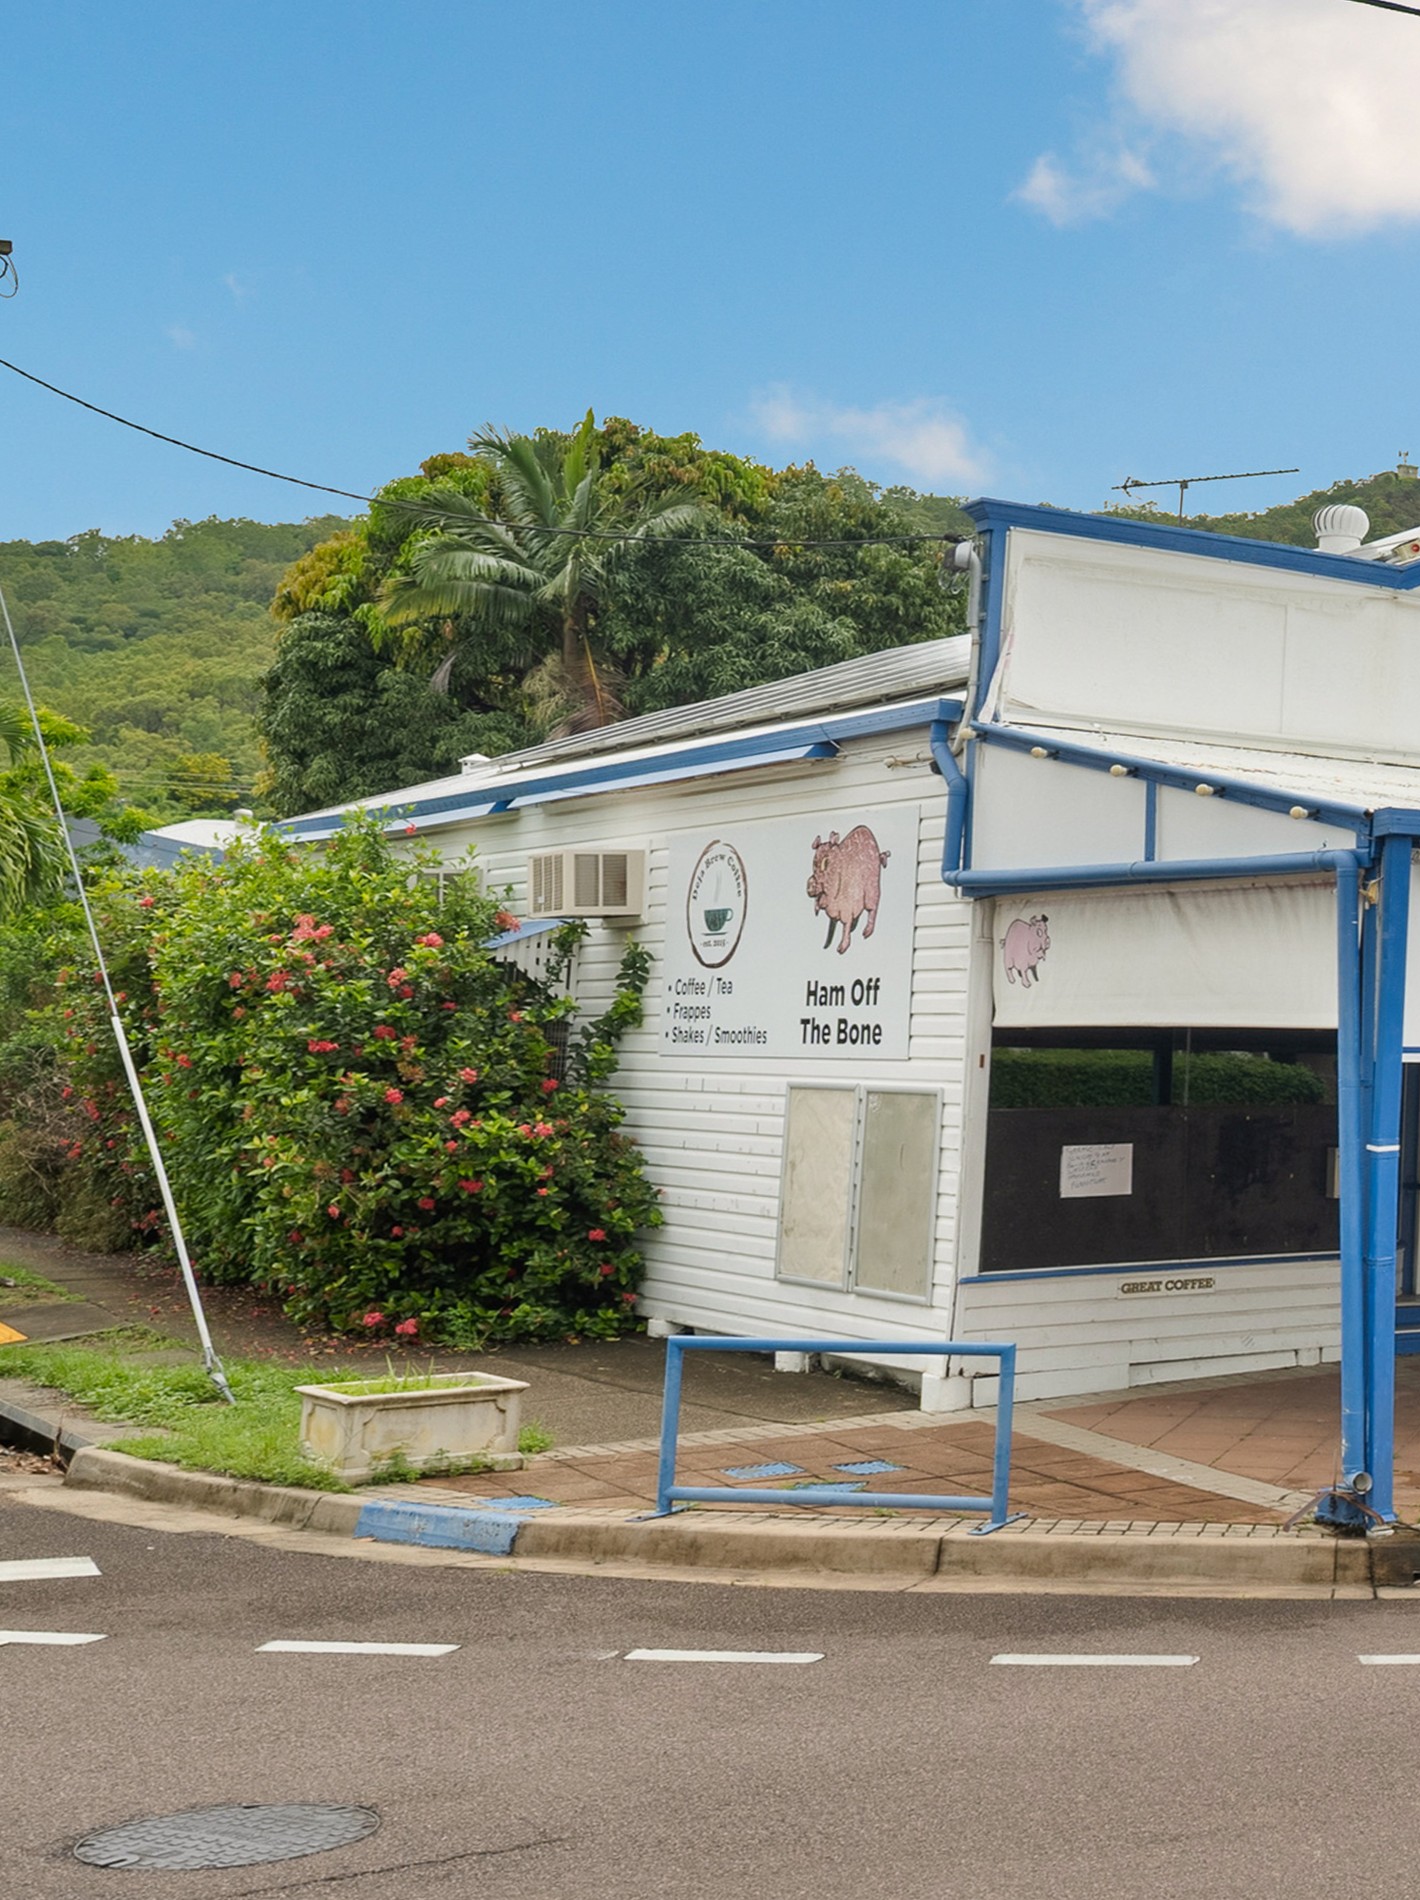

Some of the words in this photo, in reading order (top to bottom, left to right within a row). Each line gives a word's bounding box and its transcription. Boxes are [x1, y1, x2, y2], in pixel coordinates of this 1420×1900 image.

[675, 978, 705, 996] Coffee
[716, 977, 733, 995] Tea
[806, 981, 845, 1006] Ham
[851, 977, 881, 1006] Off
[673, 1003, 711, 1023] Frappes
[671, 1026, 704, 1044] Shakes
[714, 1026, 768, 1045] Smoothies
[800, 1017, 831, 1044] The
[837, 1018, 883, 1045] Bone
[1120, 1281, 1162, 1294] GREAT
[1165, 1277, 1213, 1292] COFFEE
